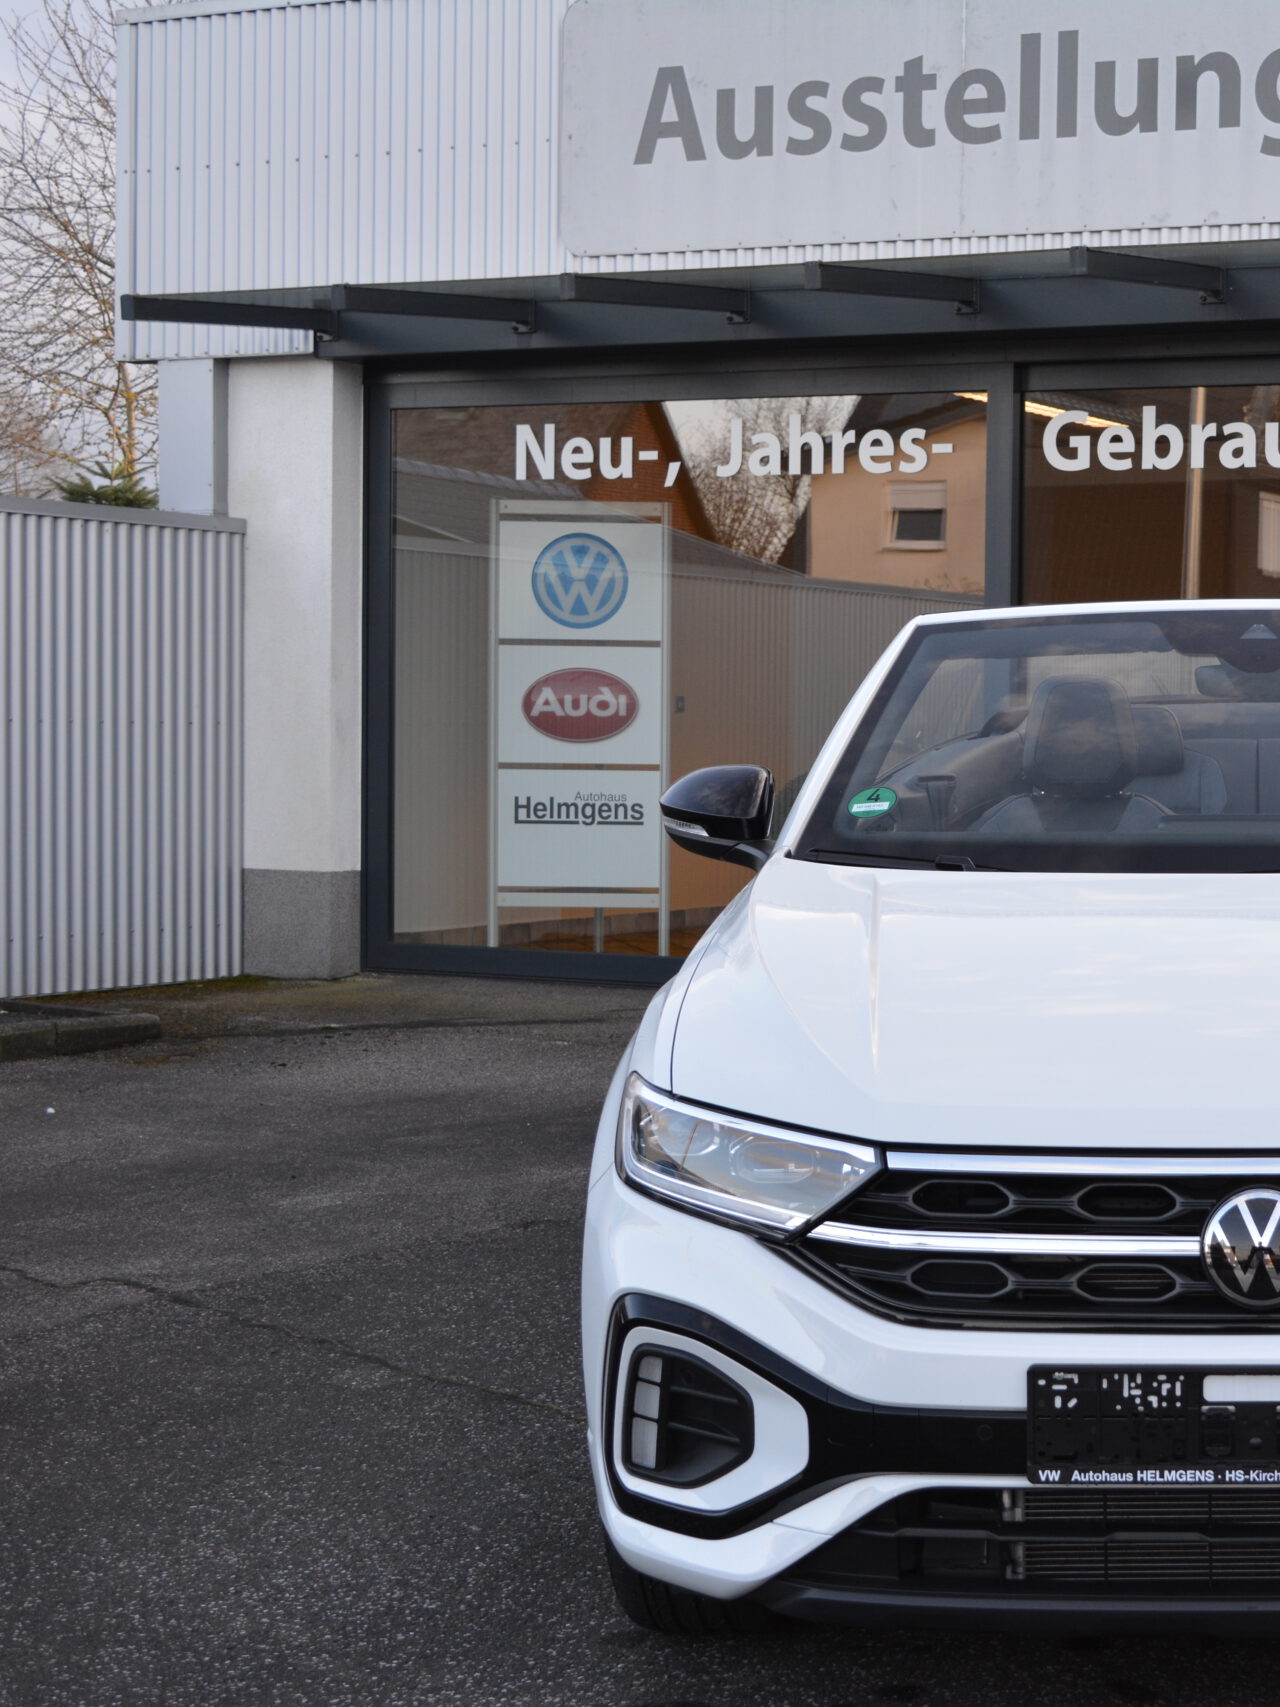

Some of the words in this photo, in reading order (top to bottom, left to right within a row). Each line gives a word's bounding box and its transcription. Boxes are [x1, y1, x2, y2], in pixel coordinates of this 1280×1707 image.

[514, 422, 682, 488] Neu-,
[716, 413, 954, 479] Jahres-
[535, 536, 626, 626] VW
[529, 687, 628, 717] Audi
[574, 791, 628, 802] Autohaus
[867, 788, 881, 802] 4
[514, 796, 645, 826] Helmgens
[1038, 1469, 1061, 1482] VW
[1070, 1469, 1134, 1482] Autohaus
[1136, 1469, 1215, 1482] HELMGENS
